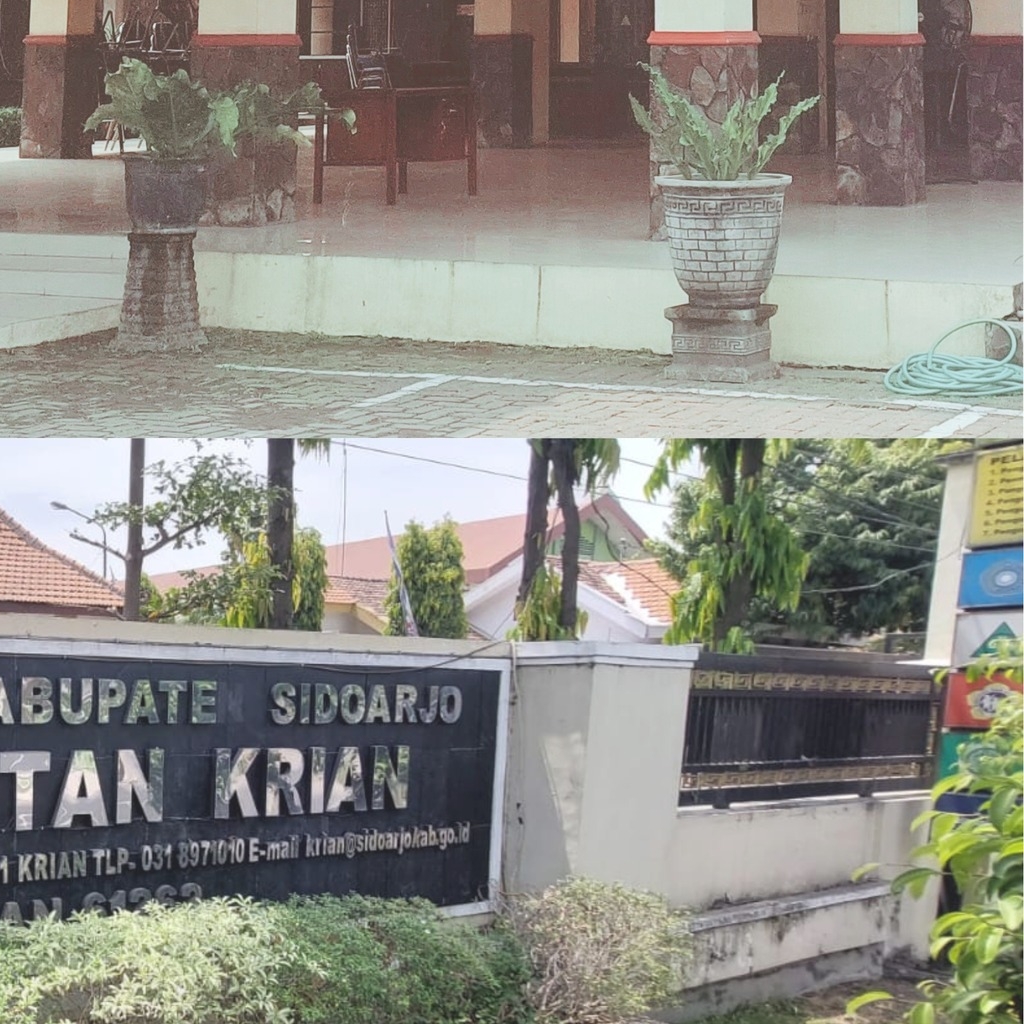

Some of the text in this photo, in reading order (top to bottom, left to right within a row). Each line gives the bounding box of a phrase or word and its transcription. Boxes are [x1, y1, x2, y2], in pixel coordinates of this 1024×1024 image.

[270, 682, 463, 725] SIDOARJO
[213, 745, 411, 819] KRIAN
[18, 849, 88, 883] KRIAN
[141, 843, 173, 871] 031
[178, 837, 245, 868] 8971010
[248, 833, 300, 863] E-mail
